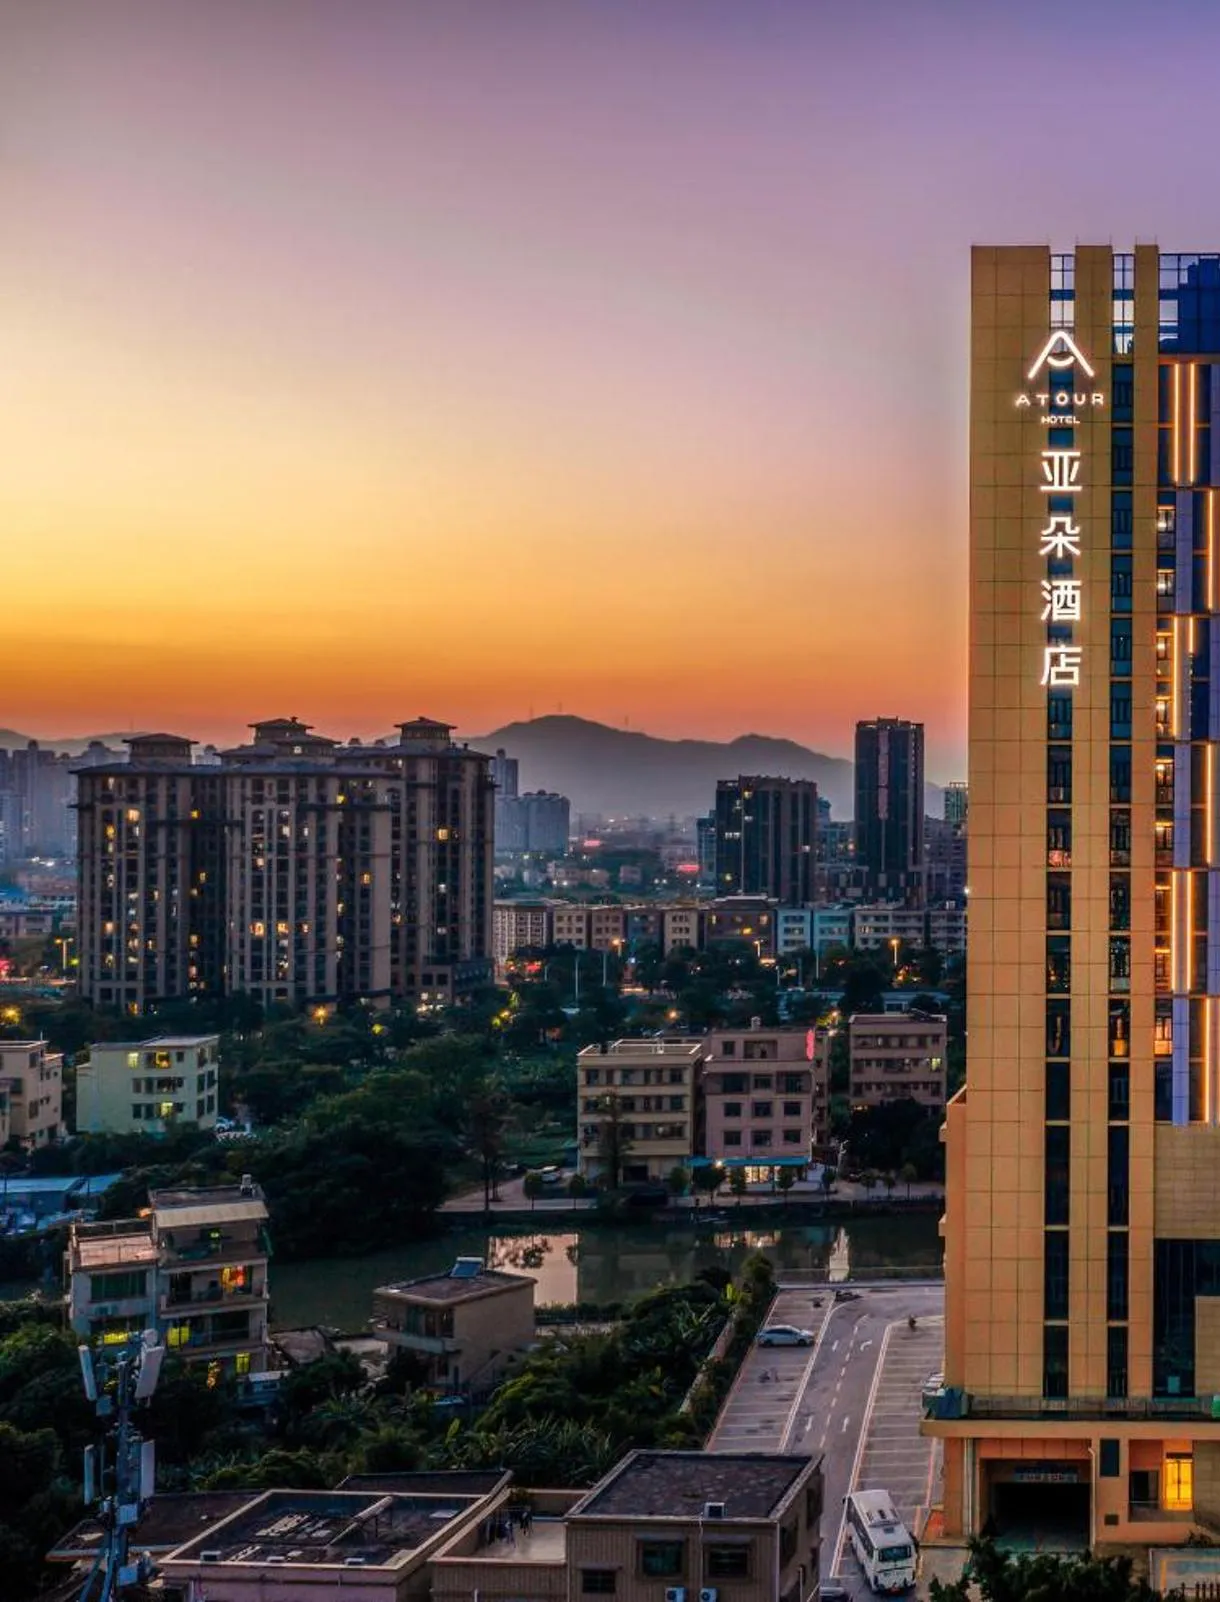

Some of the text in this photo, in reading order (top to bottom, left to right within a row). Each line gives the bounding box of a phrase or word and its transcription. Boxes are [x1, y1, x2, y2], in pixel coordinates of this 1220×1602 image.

[1014, 392, 1105, 408] ATOUR
[1040, 415, 1081, 424] HOTEL
[1038, 450, 1083, 687] 亚朵酒店
